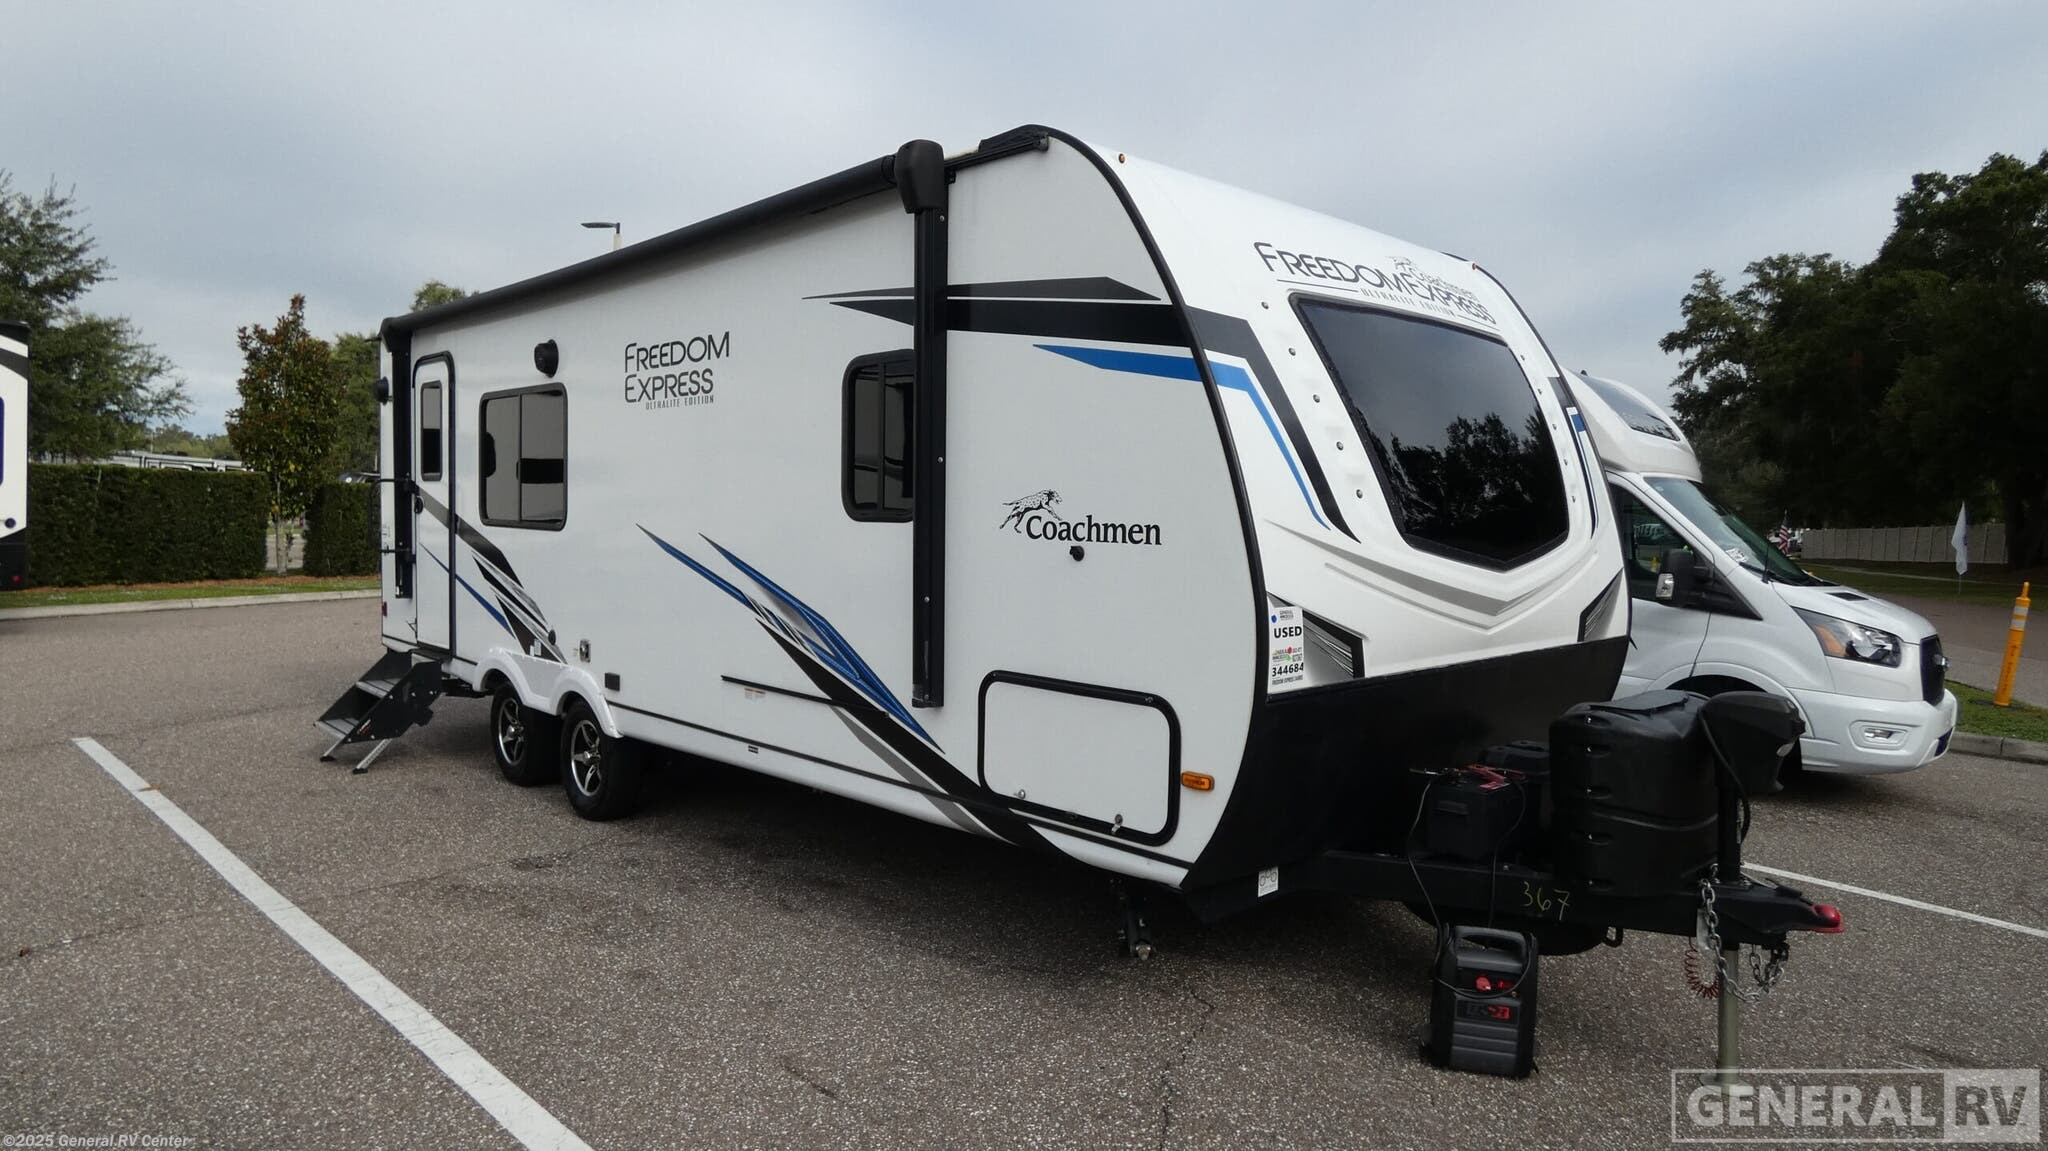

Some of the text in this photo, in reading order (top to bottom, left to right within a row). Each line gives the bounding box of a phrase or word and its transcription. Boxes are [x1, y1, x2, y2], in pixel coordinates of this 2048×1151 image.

[624, 331, 730, 373] FREEDOM
[624, 368, 714, 403] EXPRESS
[645, 394, 714, 410] ULTRALITE EDITION
[1026, 515, 1162, 546] Coachmen
[1273, 625, 1303, 639] USED
[1271, 662, 1304, 677] 344684
[1523, 881, 1571, 921] 367
